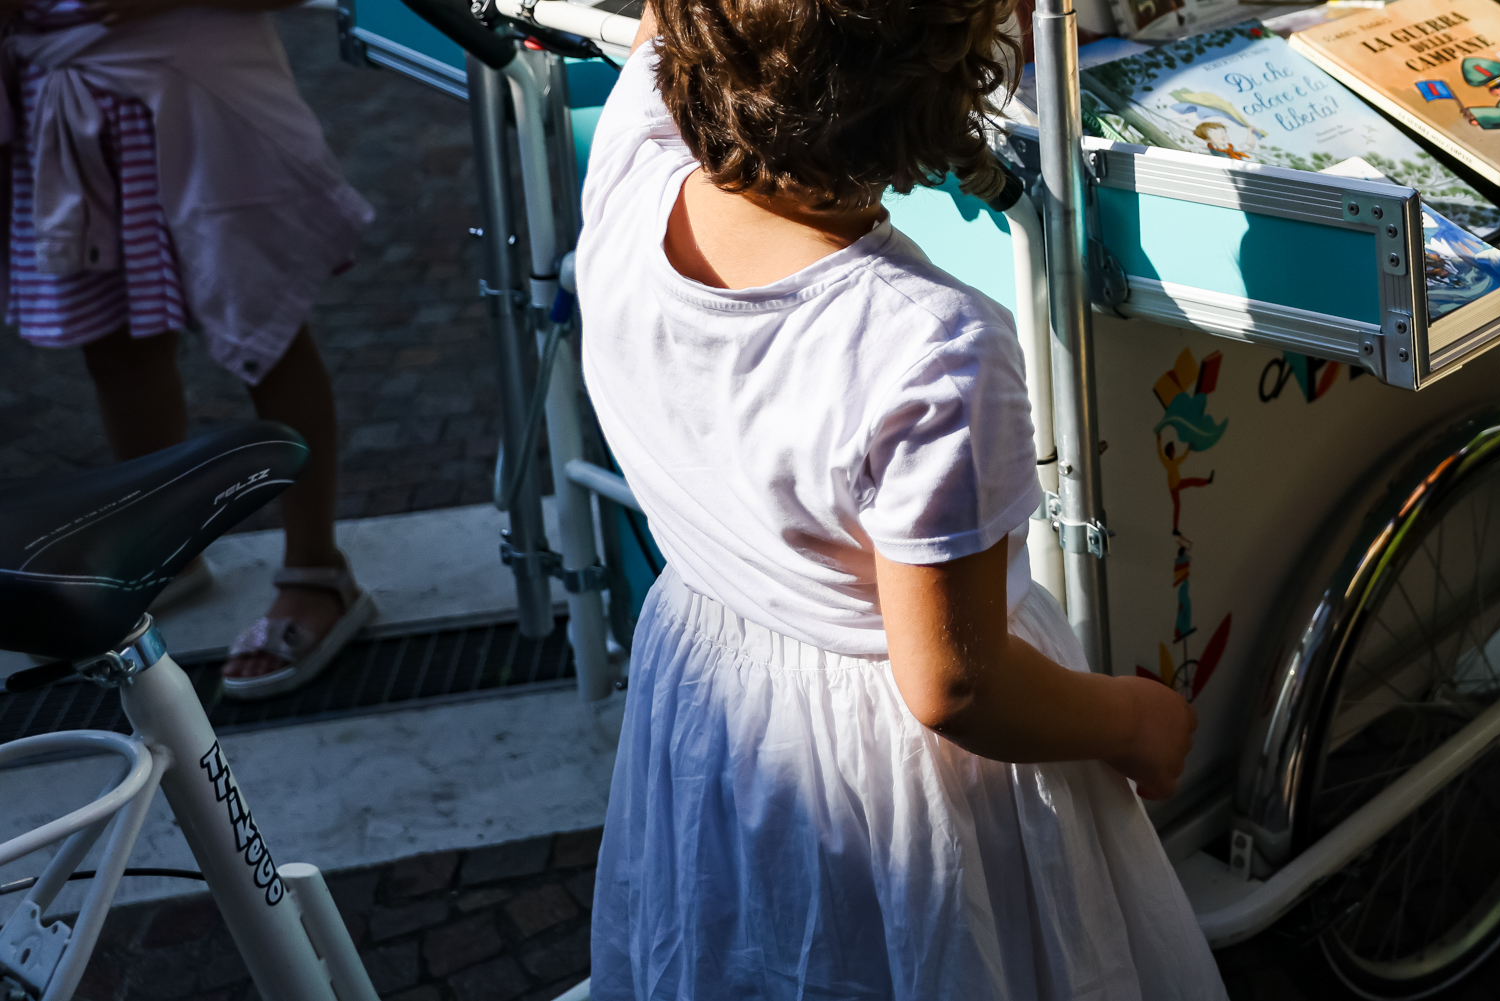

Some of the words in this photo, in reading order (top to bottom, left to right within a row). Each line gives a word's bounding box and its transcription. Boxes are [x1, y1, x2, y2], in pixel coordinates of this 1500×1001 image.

[1360, 36, 1395, 53] LA
[1390, 10, 1471, 43] GUERRA
[1409, 32, 1458, 53] DELLE
[1405, 34, 1496, 72] CAMPANE
[1224, 72, 1263, 94] Di
[1262, 60, 1294, 83] che
[1242, 91, 1295, 116] colore
[1302, 75, 1329, 93] la
